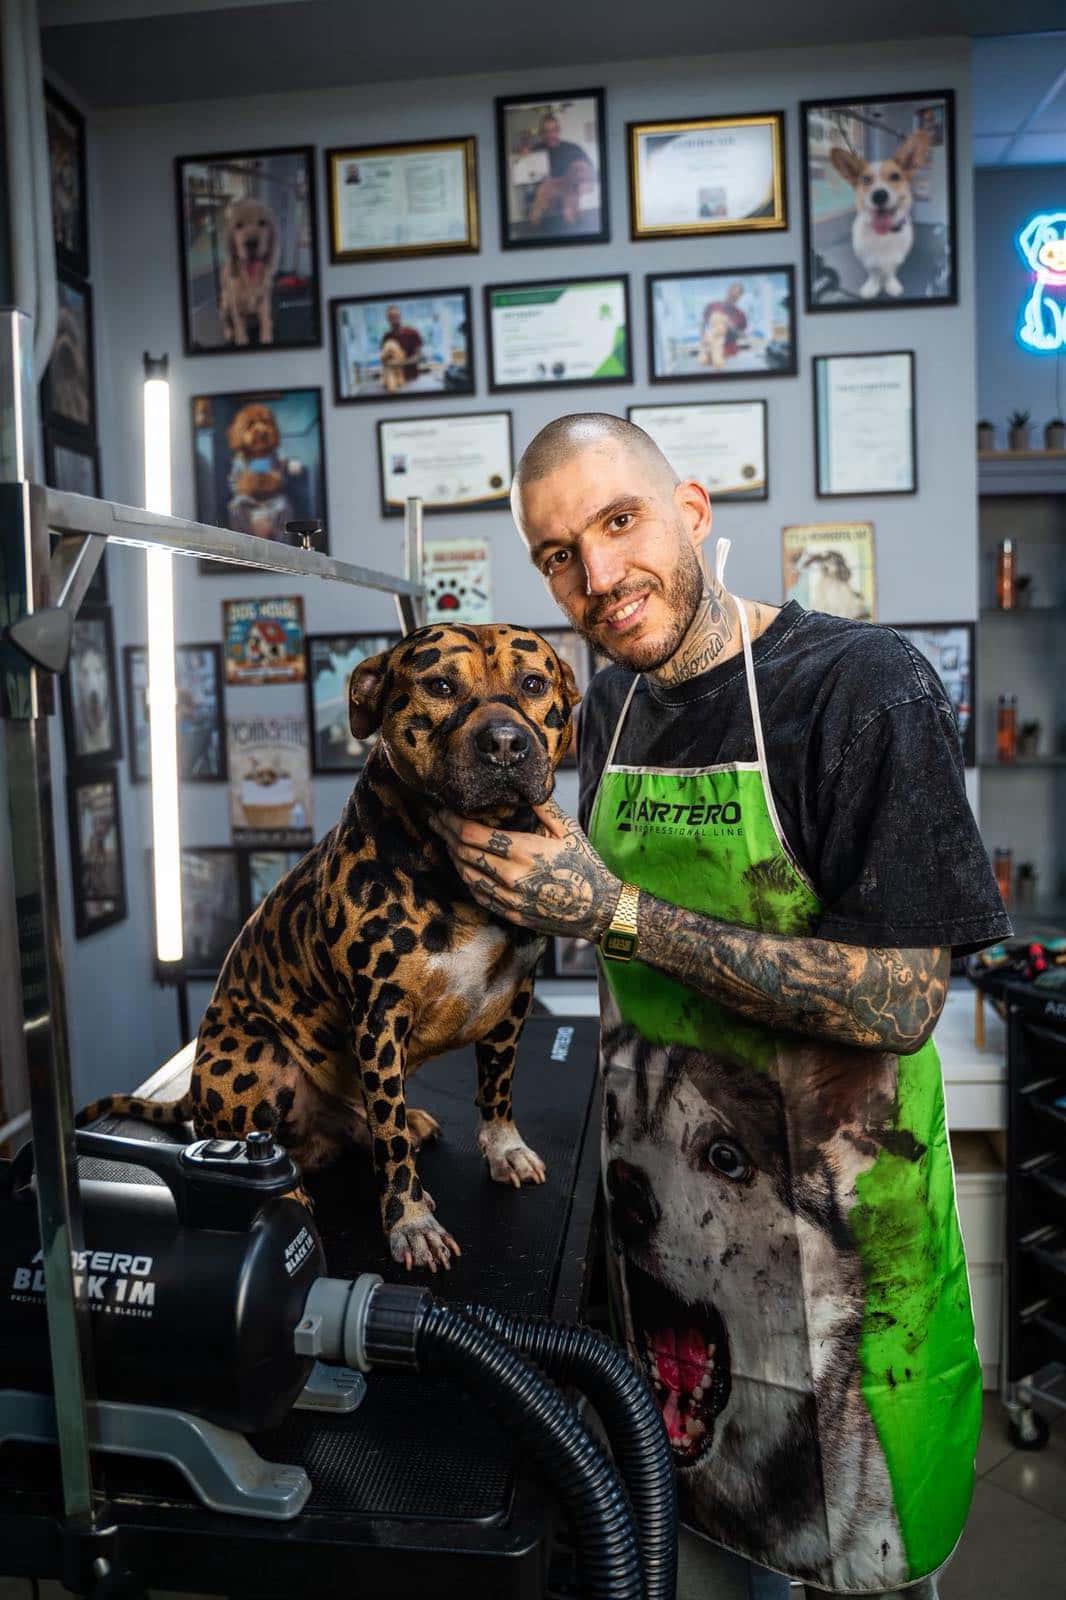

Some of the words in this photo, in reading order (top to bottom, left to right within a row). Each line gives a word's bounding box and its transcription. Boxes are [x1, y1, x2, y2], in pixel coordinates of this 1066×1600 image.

[636, 801, 742, 825] ARTERO
[634, 824, 706, 837] PROFESSIONAL
[714, 828, 744, 836] LINE
[12, 1266, 109, 1300] BLK
